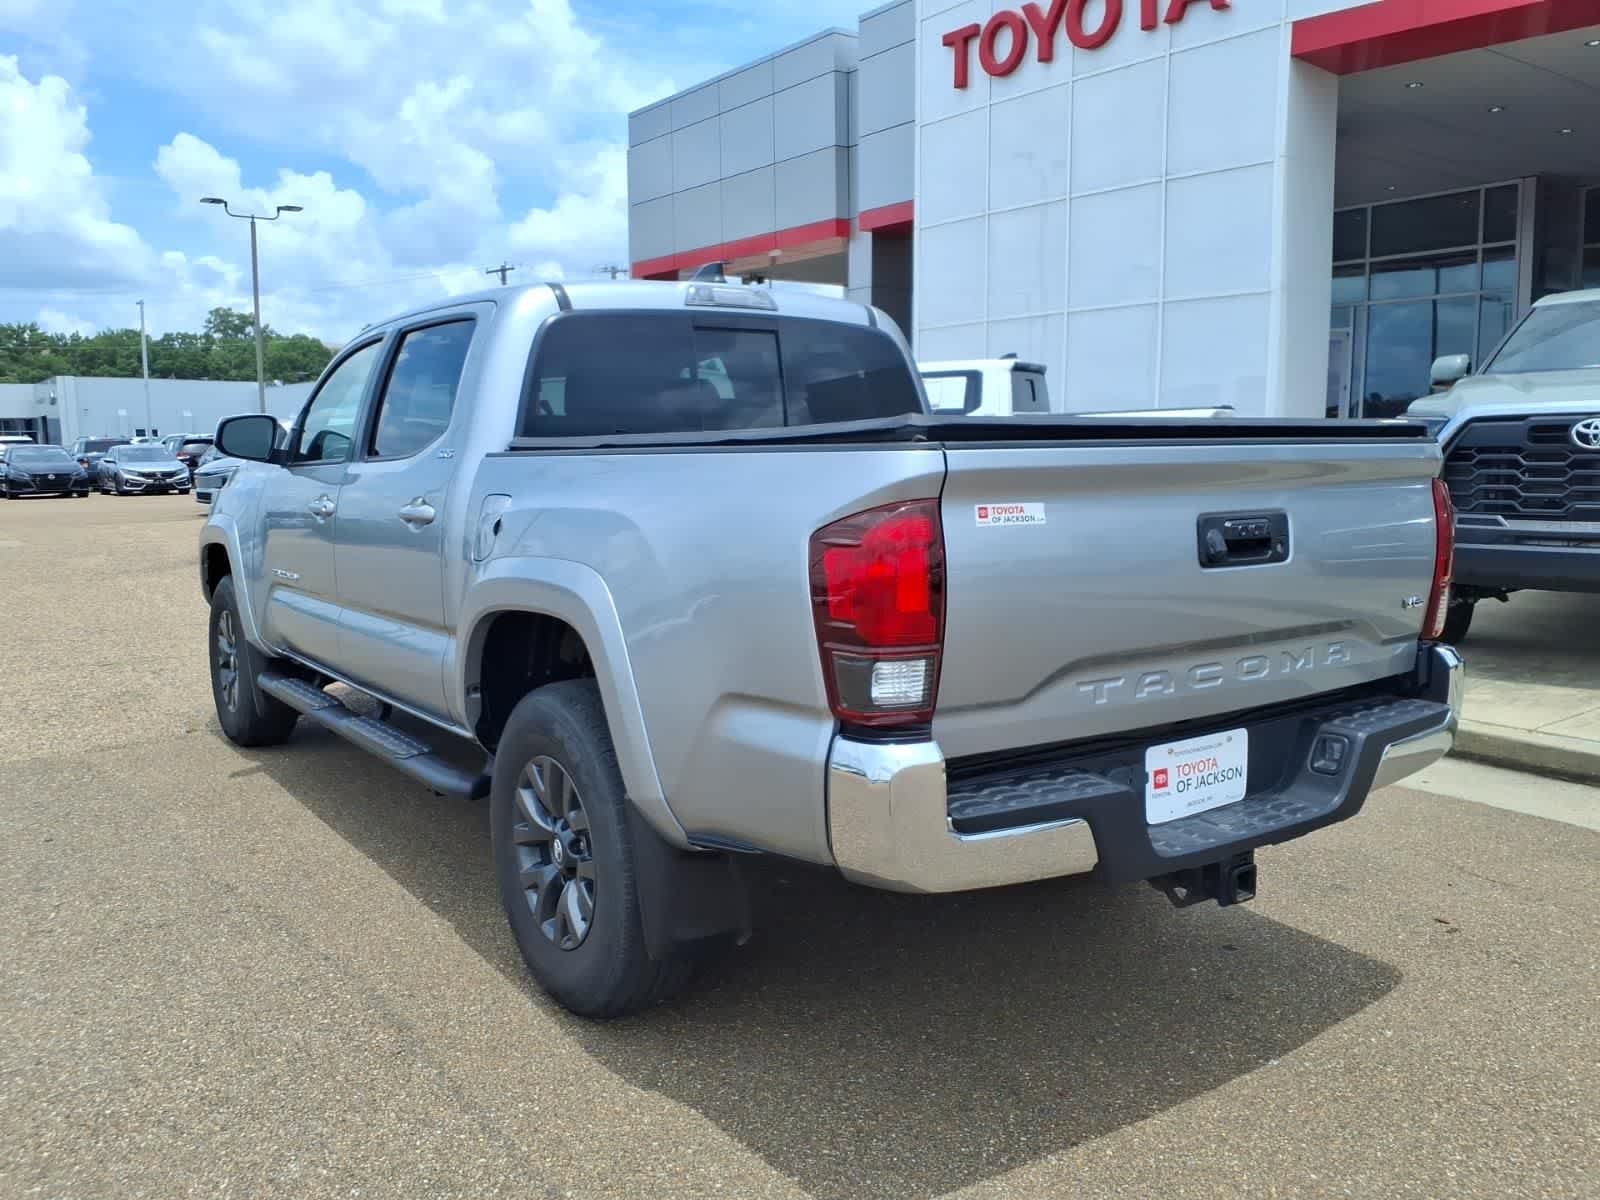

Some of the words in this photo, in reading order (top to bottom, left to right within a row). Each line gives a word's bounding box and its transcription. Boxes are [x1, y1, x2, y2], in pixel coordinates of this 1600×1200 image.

[991, 506, 1025, 515] TOYOTA
[1003, 515, 1035, 523] JACKSON
[1076, 641, 1351, 705] TACOMA
[1176, 757, 1218, 777] TOYOTA
[1176, 778, 1192, 793] OF
[1194, 766, 1243, 790] JACKSON
